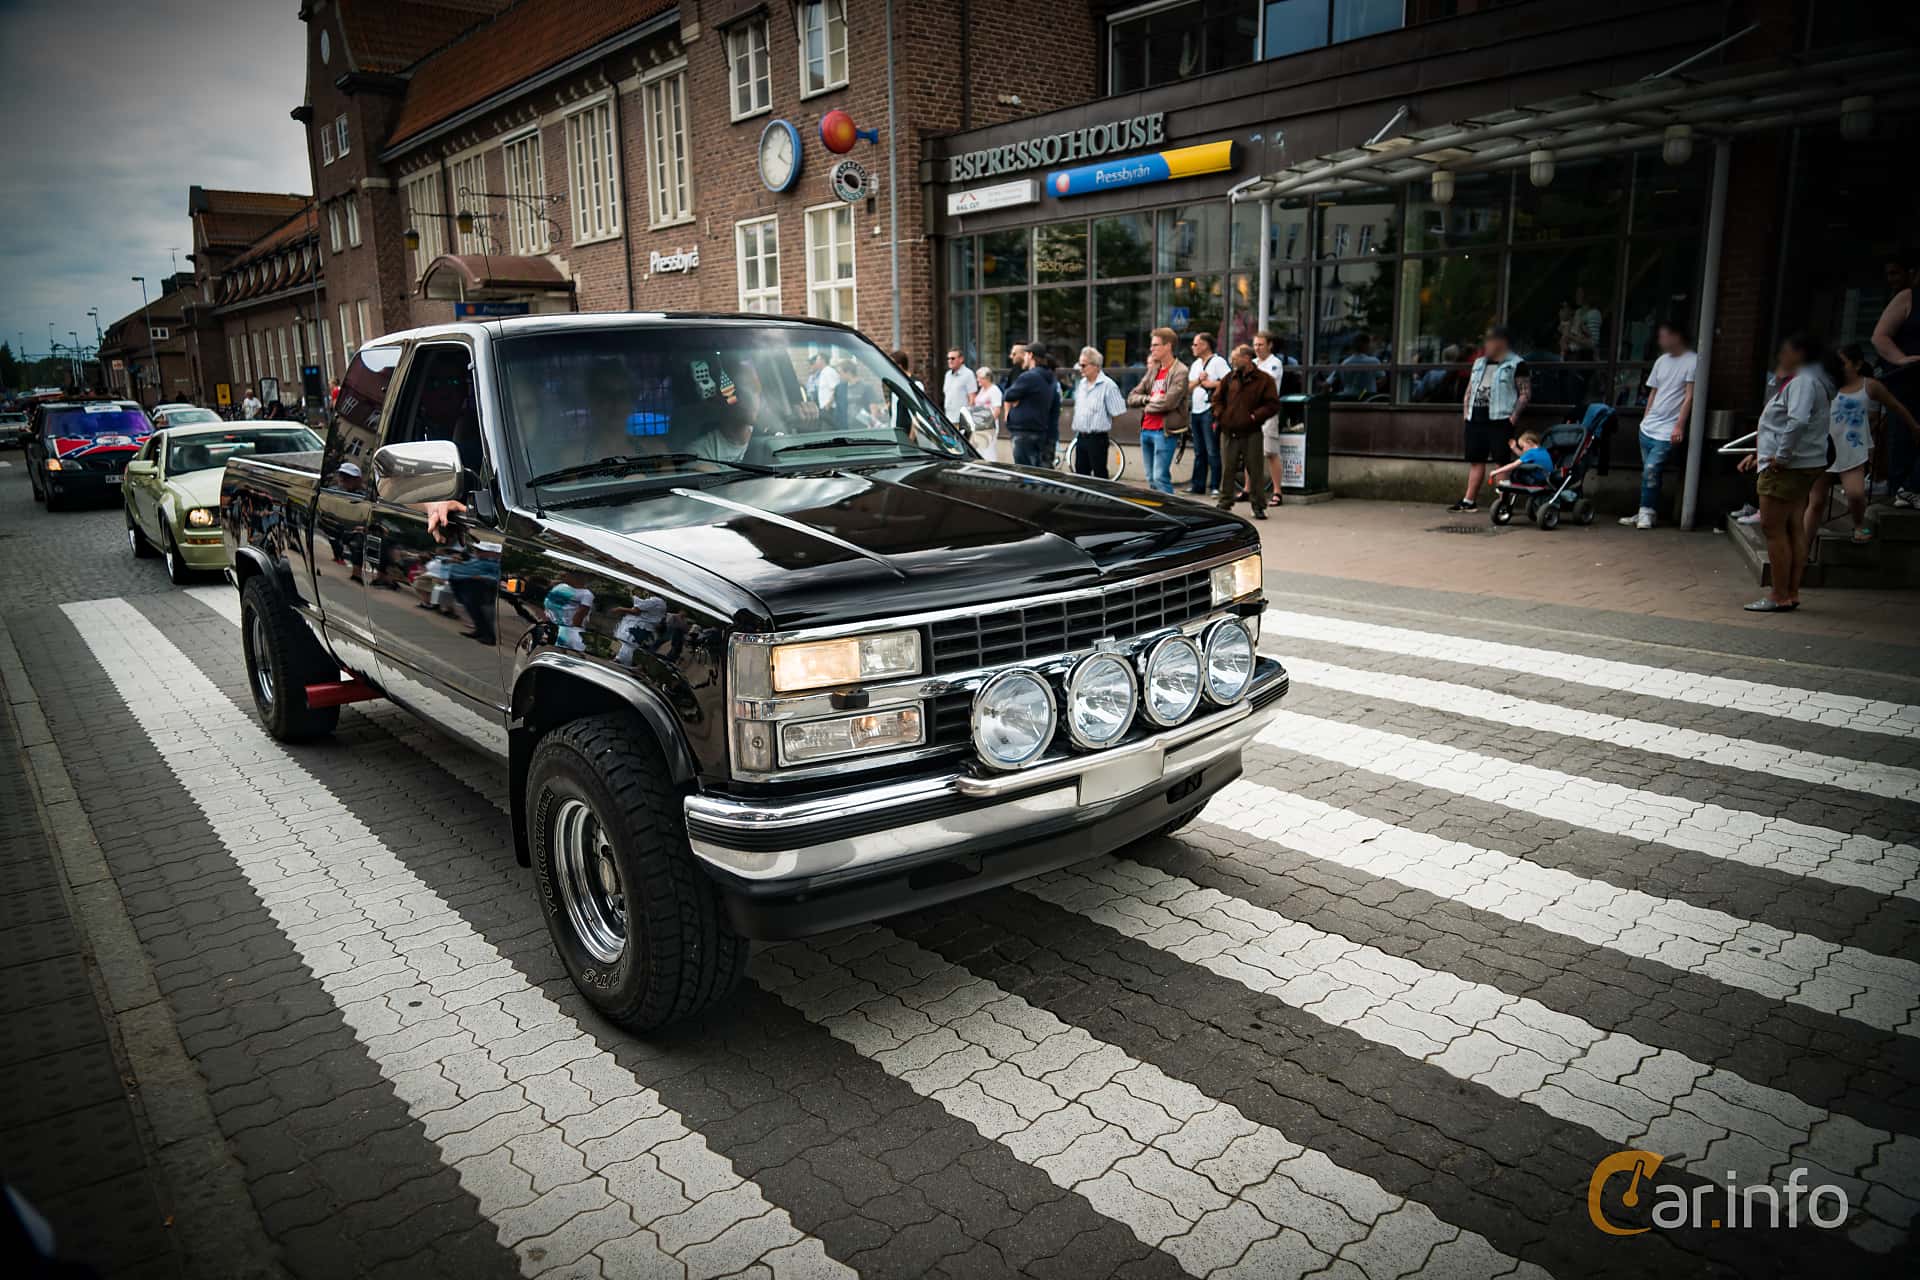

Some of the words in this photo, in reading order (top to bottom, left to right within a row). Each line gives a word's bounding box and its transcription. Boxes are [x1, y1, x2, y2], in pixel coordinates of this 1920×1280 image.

[949, 135, 1062, 183] ESPRESSO
[1058, 112, 1164, 162] HOUSE
[1095, 163, 1150, 184] Pressbyrån
[535, 784, 558, 917] YOKOHAMA
